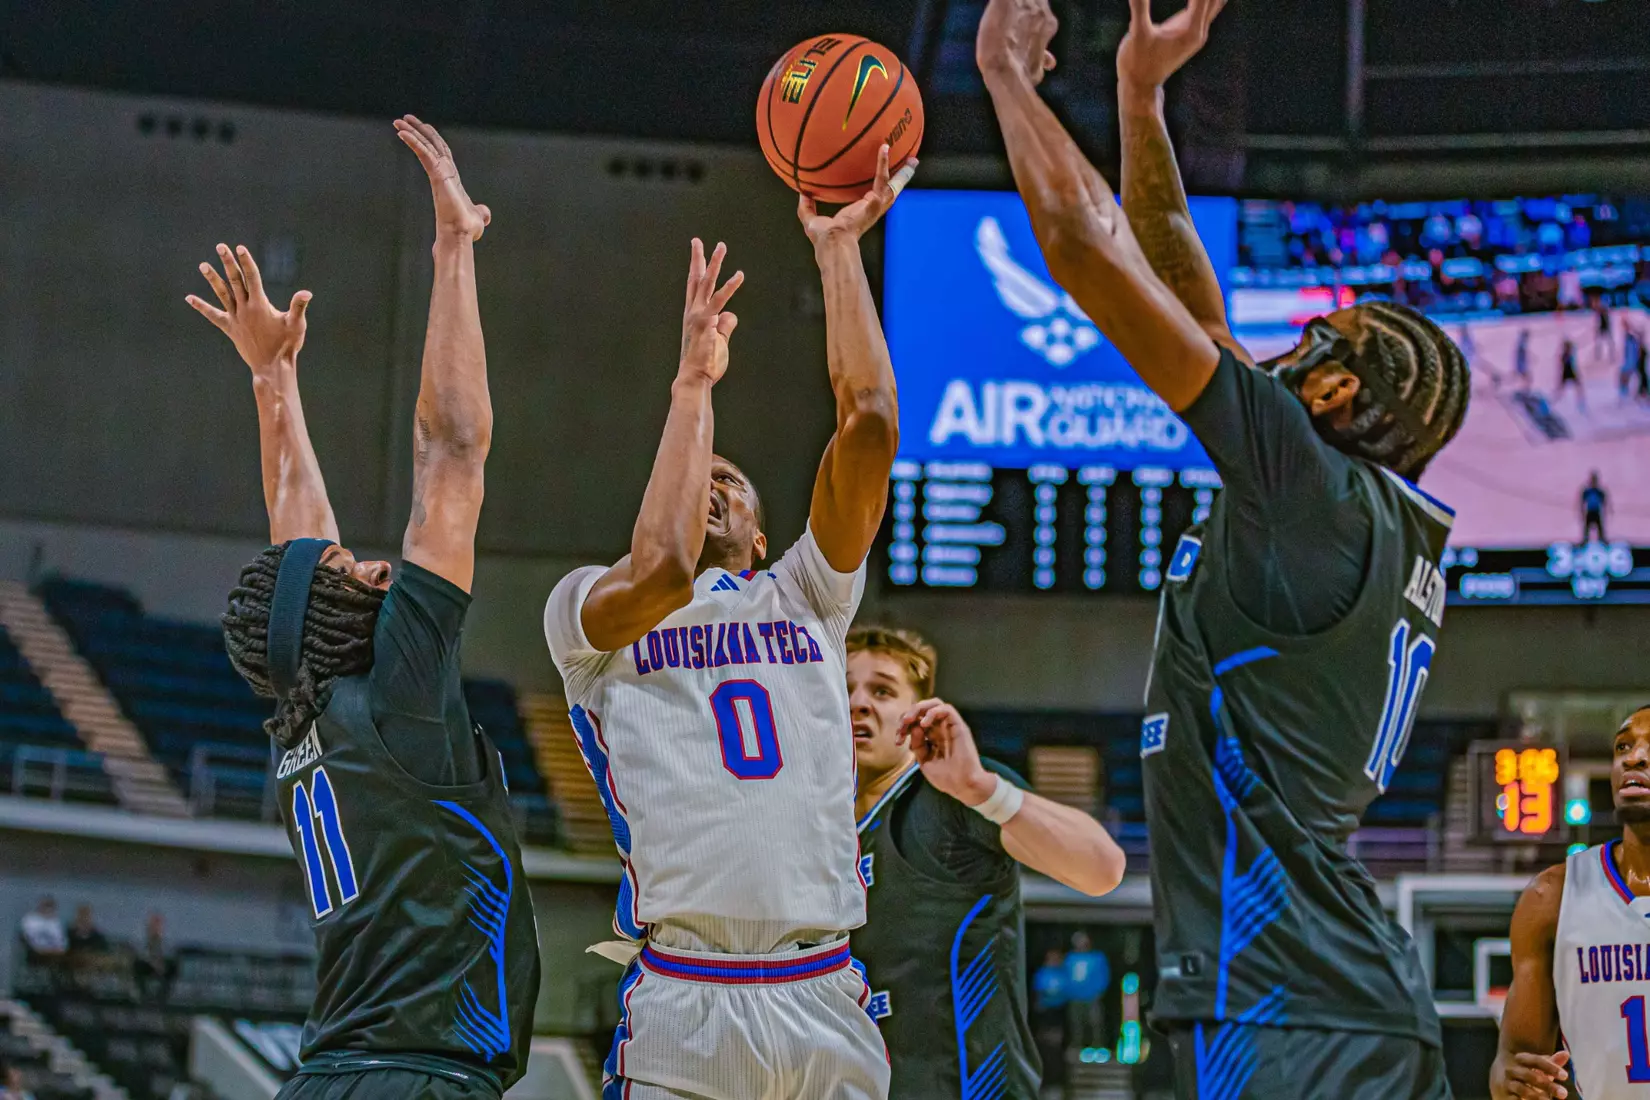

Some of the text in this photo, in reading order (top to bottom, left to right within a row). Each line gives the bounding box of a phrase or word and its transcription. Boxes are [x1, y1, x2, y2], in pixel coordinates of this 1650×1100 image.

[782, 37, 843, 104] ELITE
[930, 379, 1043, 446] AIR
[708, 678, 784, 780] 0
[1503, 781, 1553, 835] 13
[292, 764, 359, 920] 11
